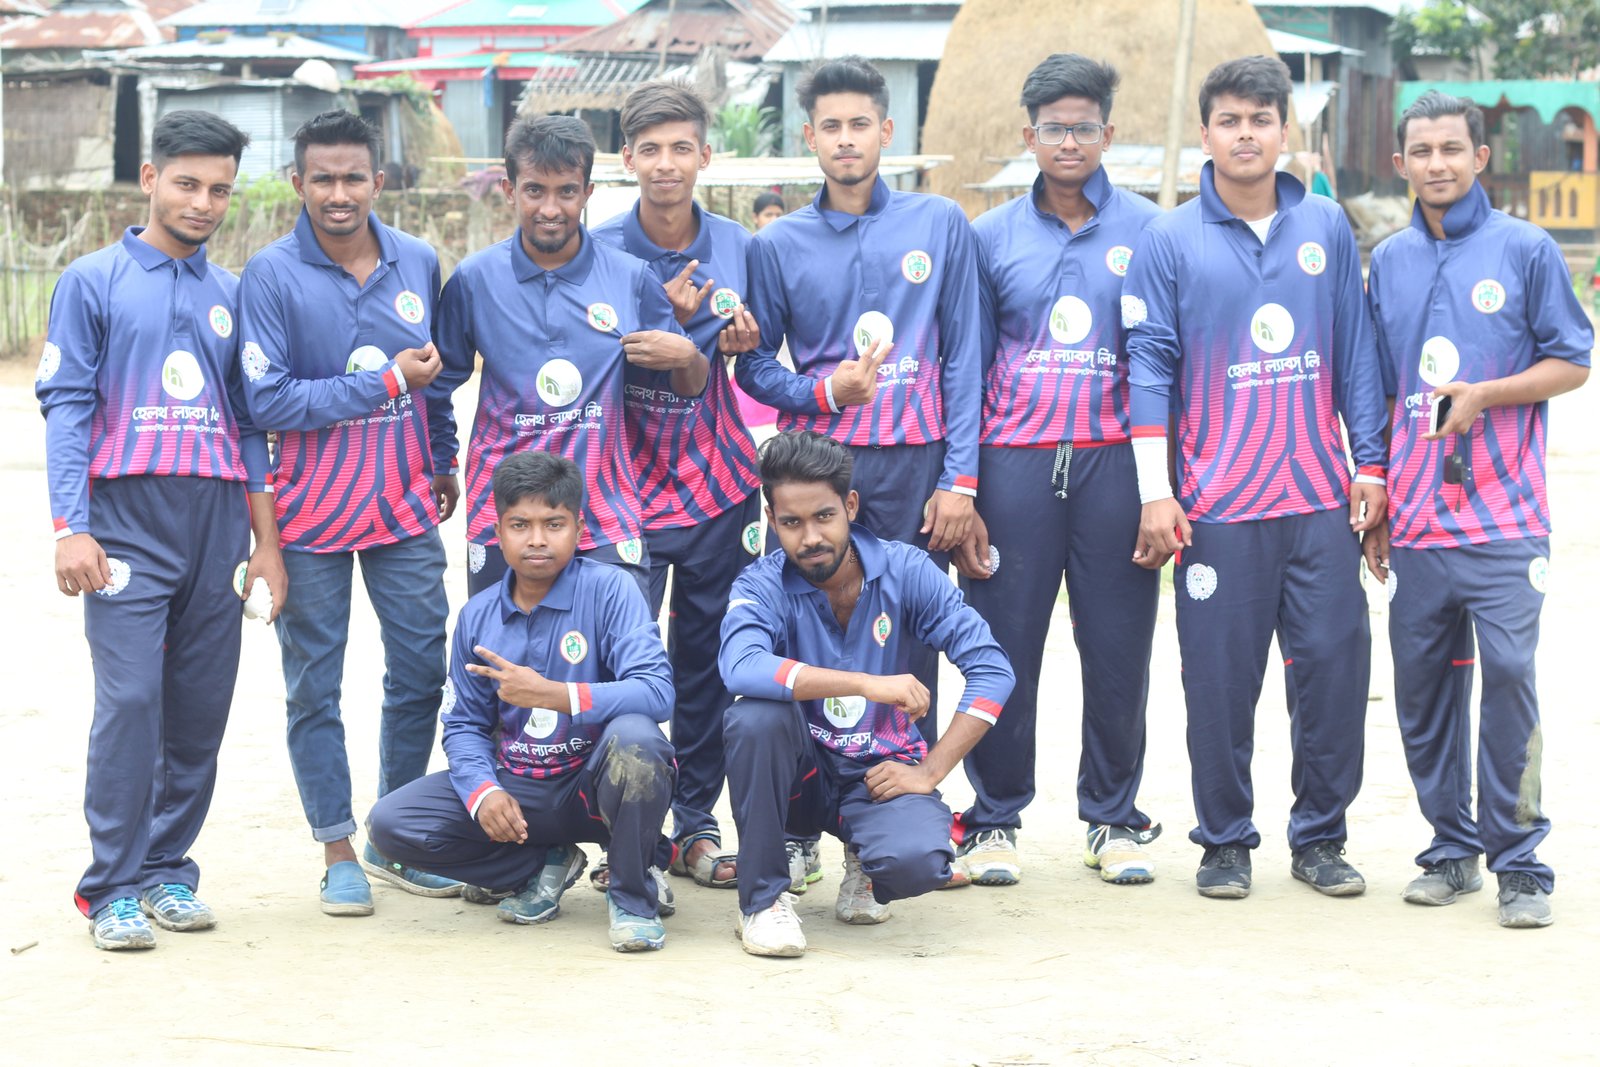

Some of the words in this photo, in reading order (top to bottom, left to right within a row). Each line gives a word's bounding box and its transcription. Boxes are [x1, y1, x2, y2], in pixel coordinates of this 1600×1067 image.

[900, 356, 919, 373] লিঃ
[1097, 347, 1117, 366] লিঃ
[1227, 361, 1261, 378] হেলথ
[1264, 355, 1304, 374] ল্যাবস্
[1304, 350, 1320, 369] লি
[624, 383, 656, 401] হেলথ
[132, 405, 169, 421] হেলথ
[171, 405, 209, 426] ল্যাবস্
[514, 413, 546, 426] হেলথ
[585, 401, 603, 418] লিঃ
[530, 742, 572, 758] ল্যাবস্
